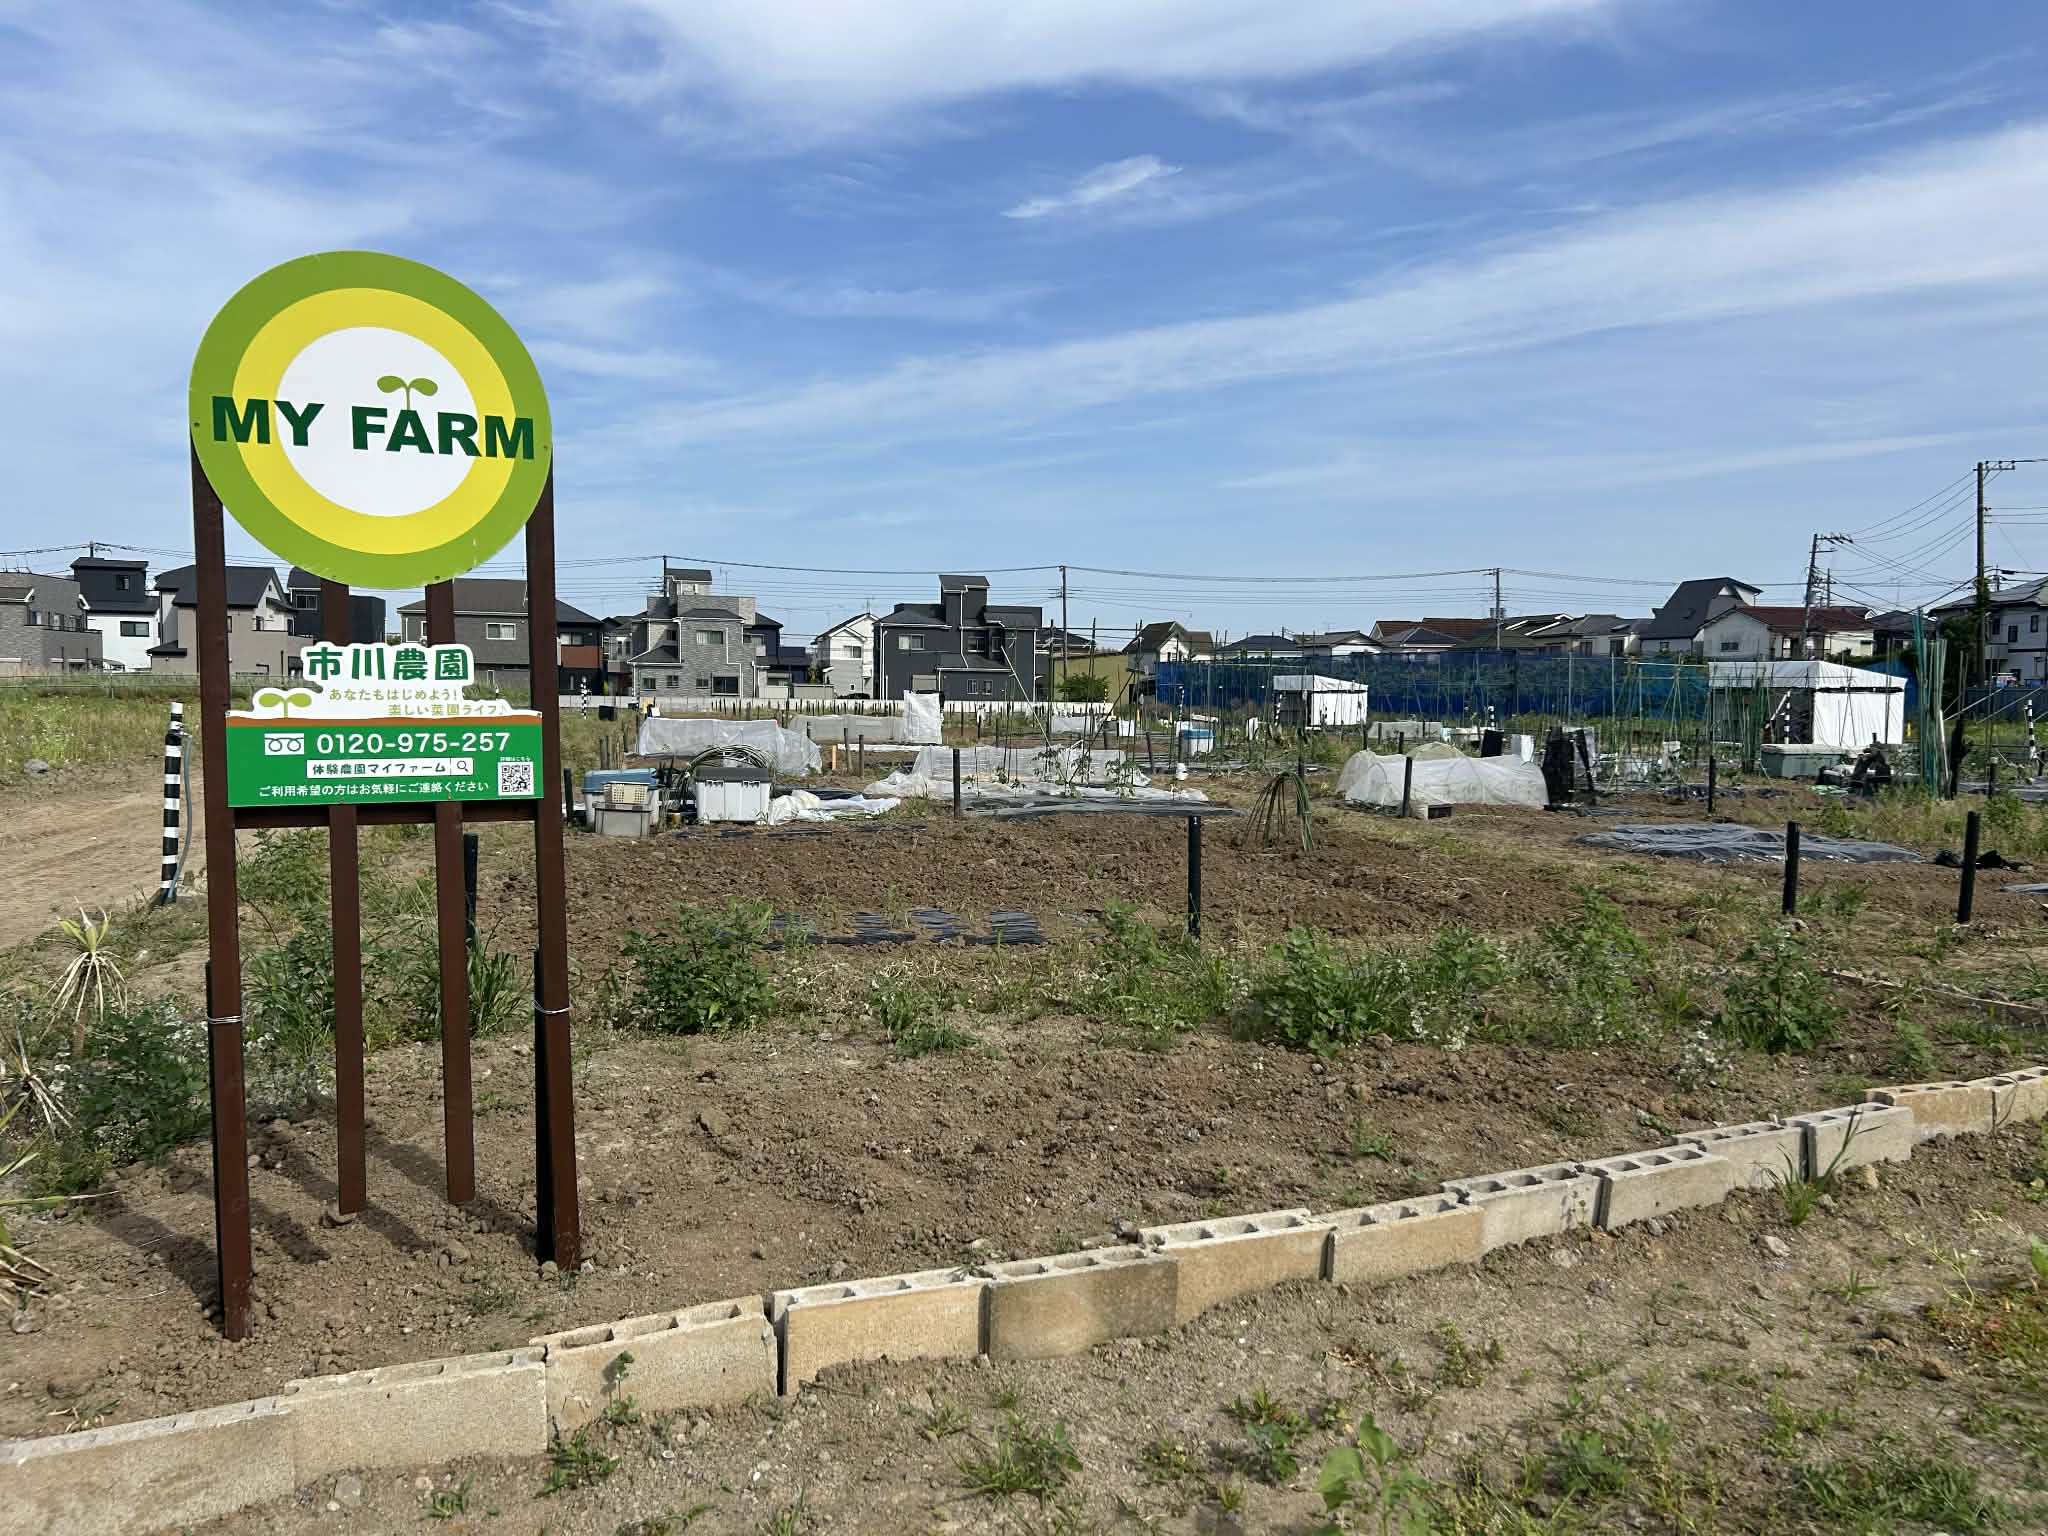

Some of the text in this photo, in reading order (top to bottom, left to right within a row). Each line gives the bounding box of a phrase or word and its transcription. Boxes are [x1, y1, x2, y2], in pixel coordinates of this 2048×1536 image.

[211, 396, 535, 460] MY FARM
[306, 646, 469, 681] 市川農園
[316, 732, 510, 754] 0120-975-257
[312, 763, 447, 775] 体験農園マイファーム
[259, 781, 489, 797] ご利用希望の方はお気軽にご連絡ください
